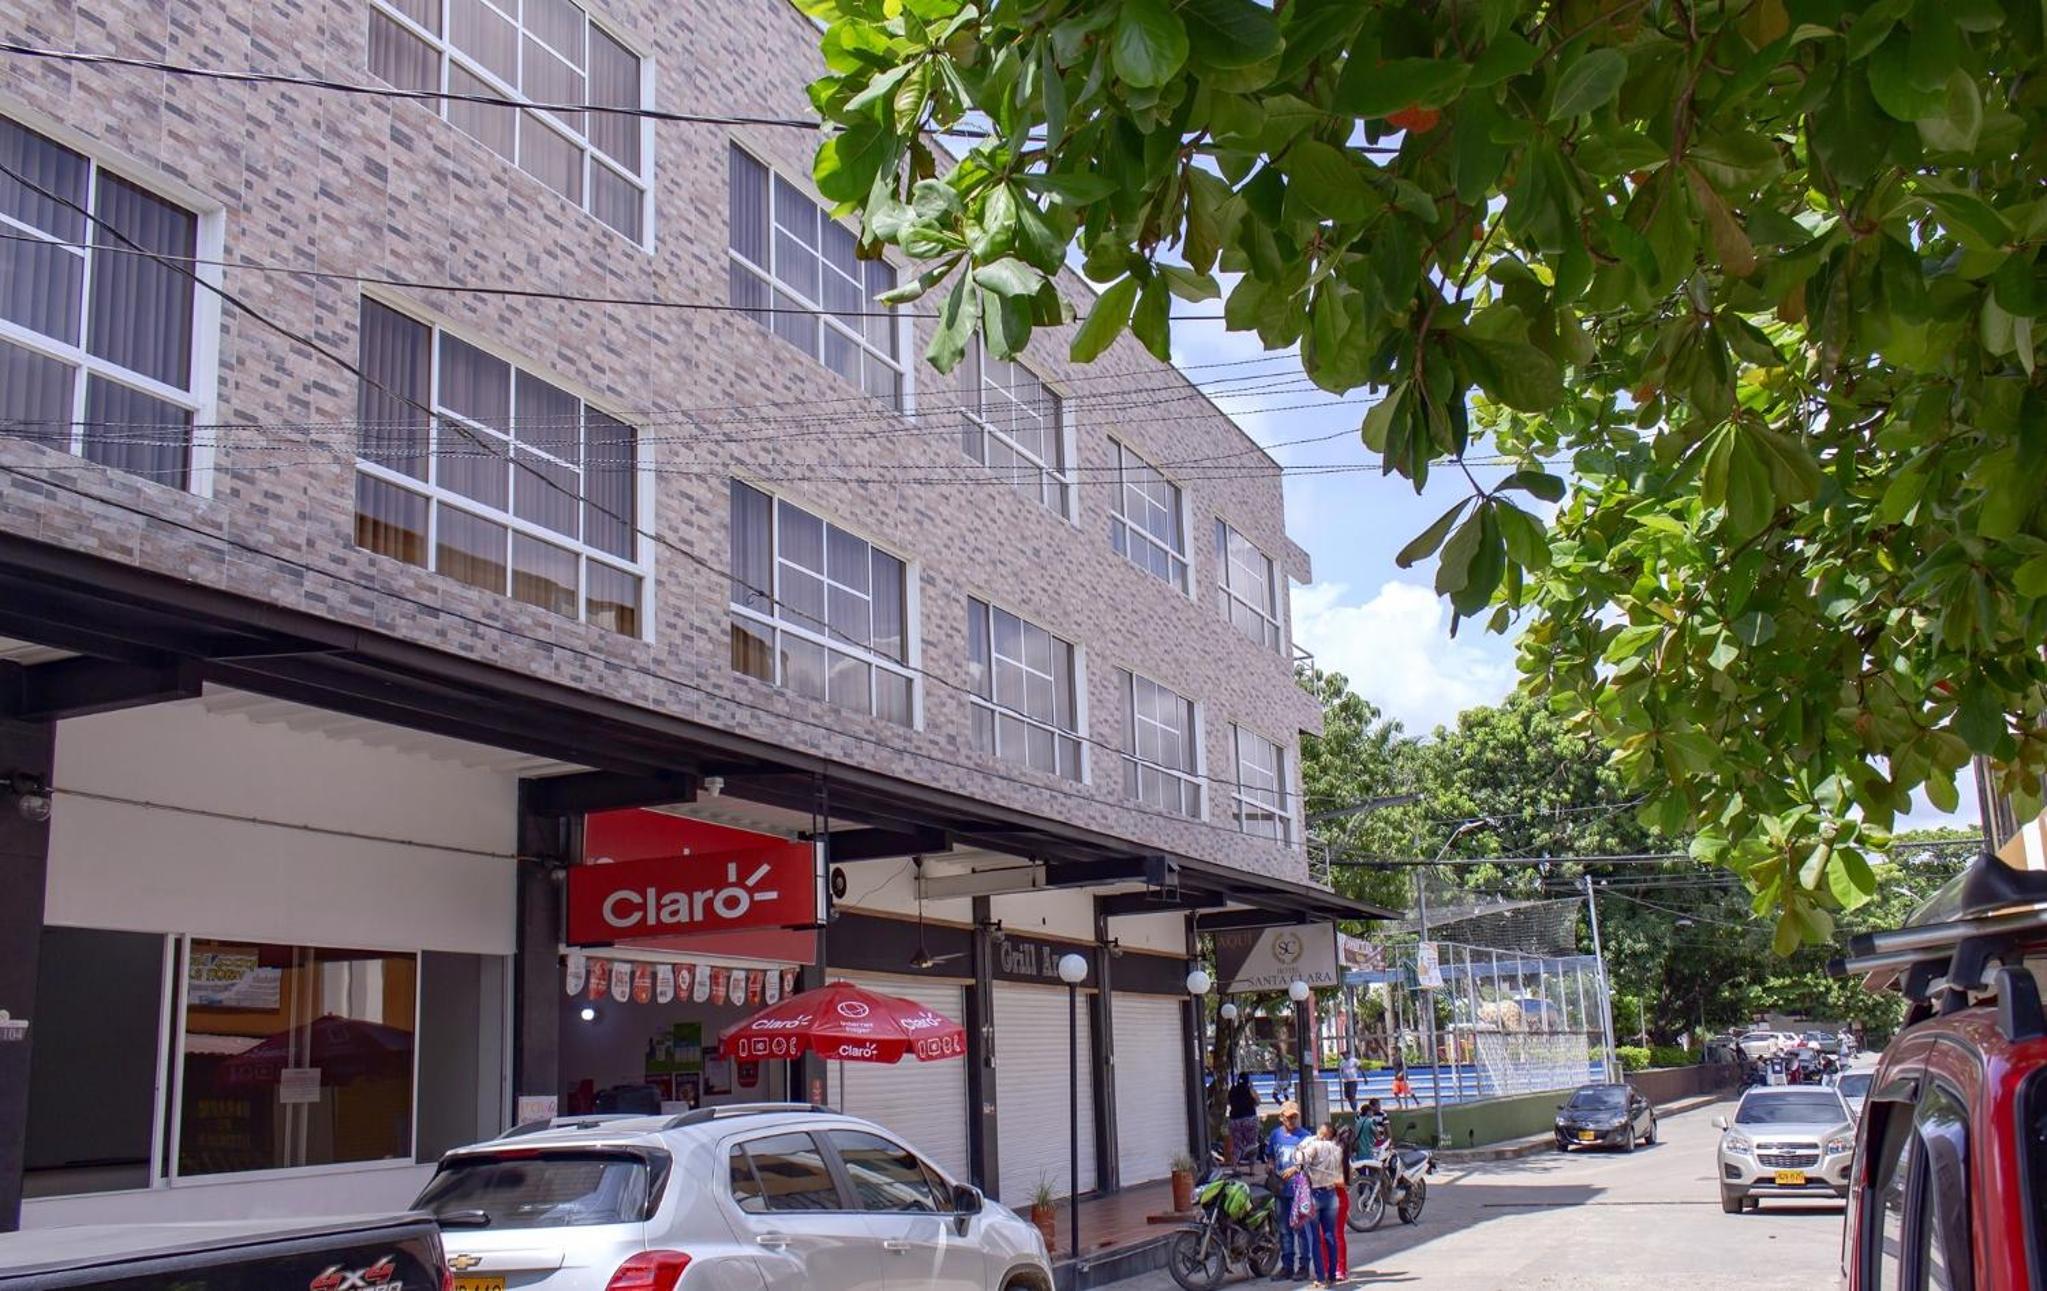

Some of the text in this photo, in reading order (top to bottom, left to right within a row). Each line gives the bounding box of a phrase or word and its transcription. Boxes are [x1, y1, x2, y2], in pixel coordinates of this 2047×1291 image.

[602, 885, 752, 928] Claro
[1001, 941, 1038, 975] Grill
[1247, 975, 1288, 987] SANTA
[751, 1017, 801, 1030] Claro
[838, 1044, 872, 1057] Claro
